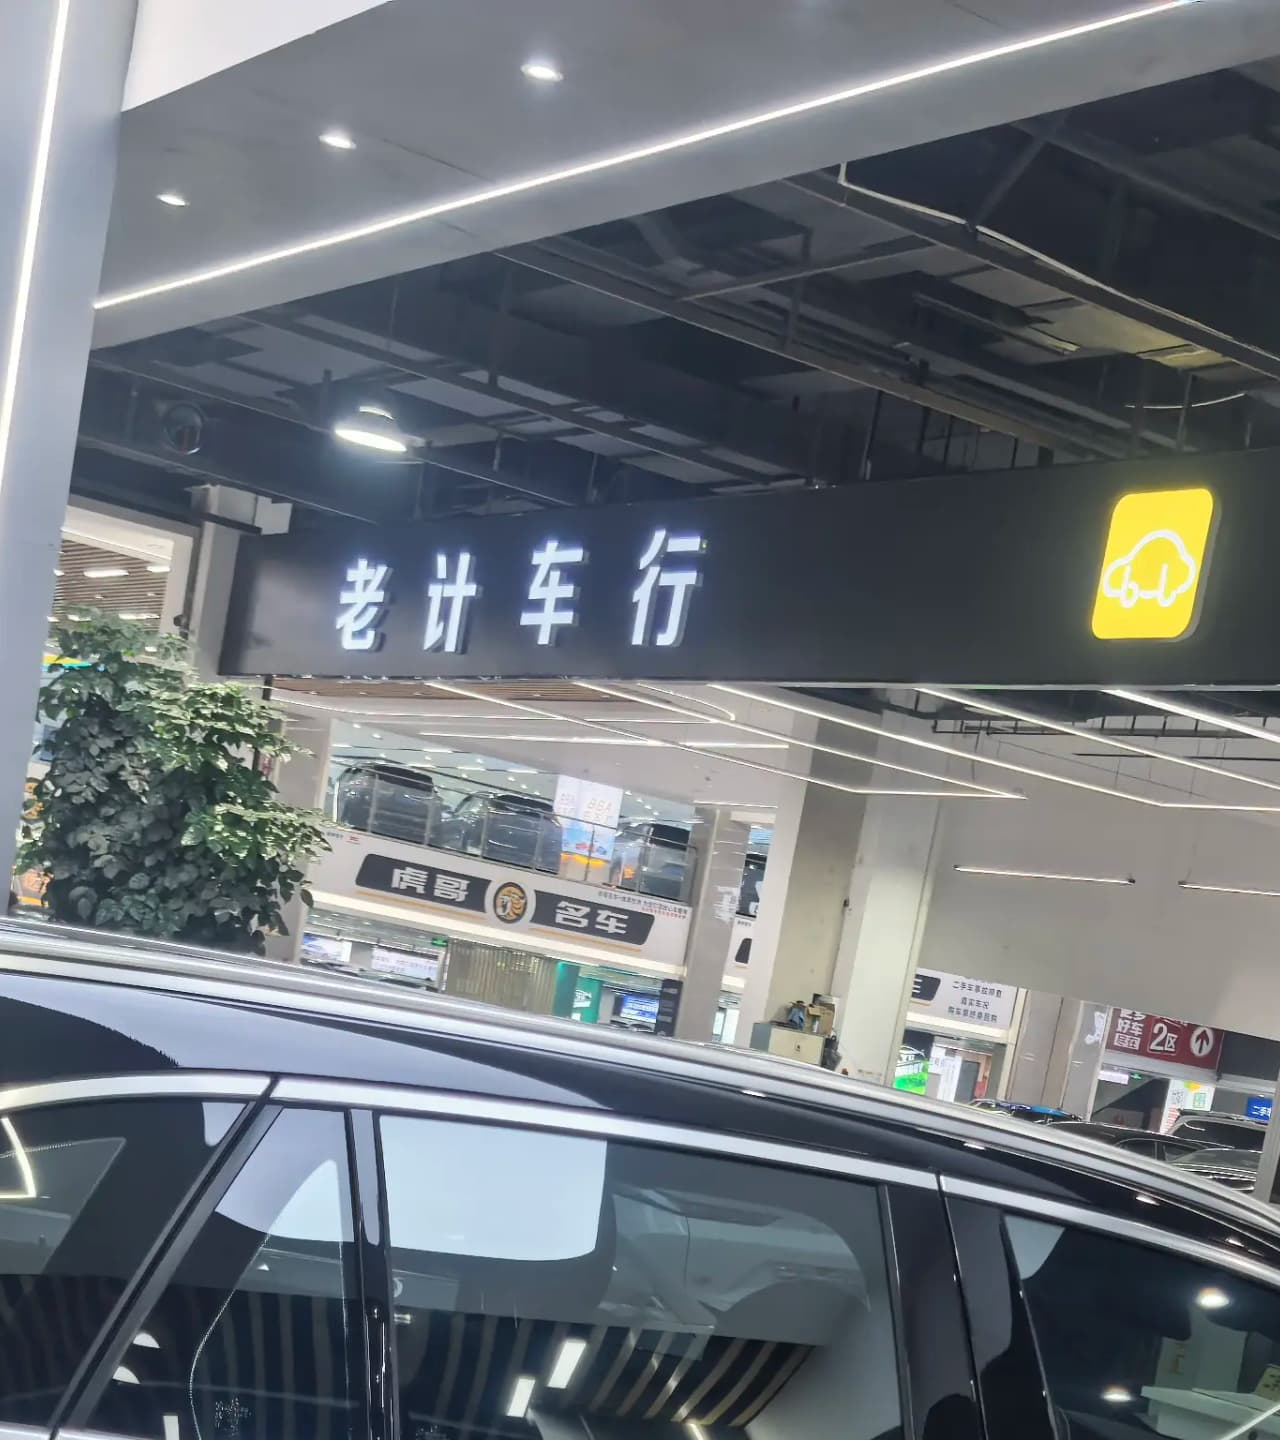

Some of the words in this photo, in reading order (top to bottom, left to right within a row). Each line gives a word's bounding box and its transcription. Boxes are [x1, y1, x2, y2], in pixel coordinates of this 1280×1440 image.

[336, 527, 708, 653] 老计车行
[391, 866, 470, 904] 虎哥
[554, 900, 631, 935] 名车
[1150, 1023, 1178, 1052] 2区
